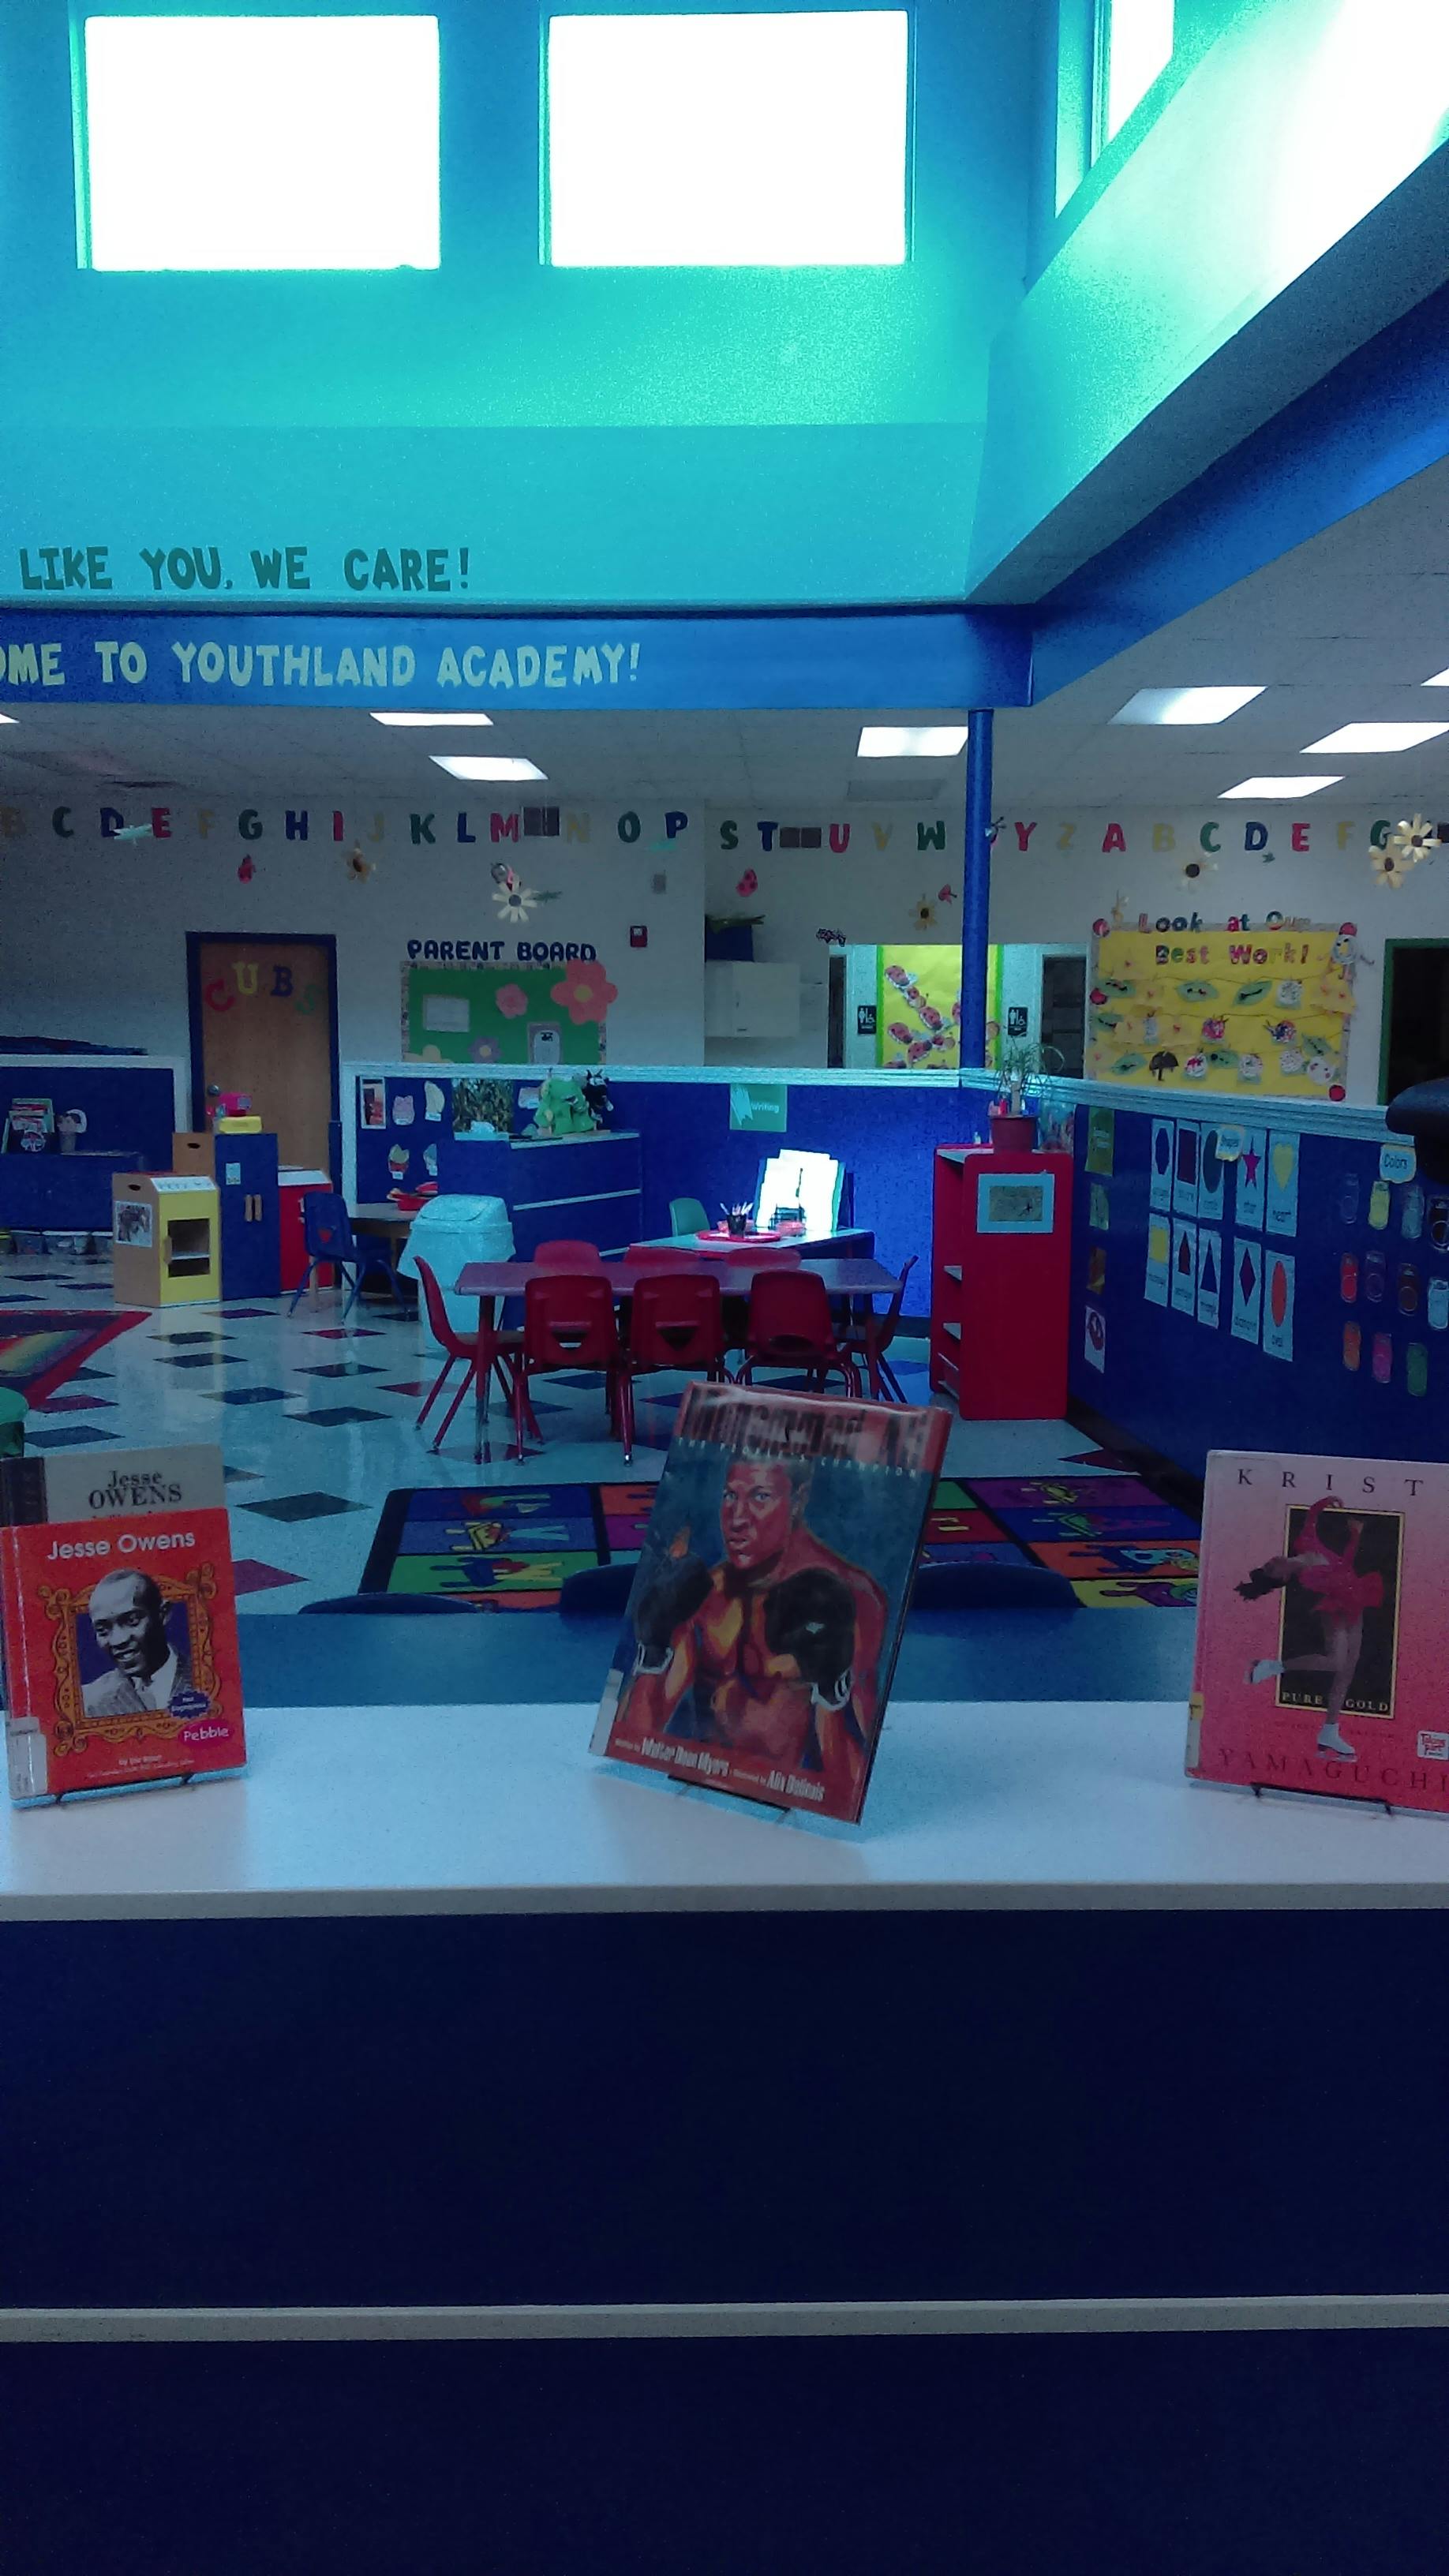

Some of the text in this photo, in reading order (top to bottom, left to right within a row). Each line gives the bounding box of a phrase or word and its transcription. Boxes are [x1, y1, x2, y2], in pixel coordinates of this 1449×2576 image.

[20, 546, 470, 591] LIKE YOU, WE CARE!
[0, 642, 640, 688] ME TO YOUTHLAND ACADEMY!
[52, 805, 74, 838] C
[100, 807, 124, 838] D
[151, 807, 172, 838] E
[197, 809, 215, 839] F
[238, 809, 264, 841] G
[285, 811, 309, 841] H
[332, 811, 343, 841] I
[410, 814, 436, 844] K
[457, 812, 476, 843] L
[489, 812, 520, 844] M
[566, 813, 590, 844] N
[617, 811, 642, 844] O
[665, 811, 688, 839] P
[720, 820, 739, 850] S
[758, 821, 778, 852] T
[829, 823, 850, 853] U
[916, 820, 945, 852] W
[1014, 822, 1038, 852] Y
[1102, 822, 1127, 852] A
[1151, 823, 1176, 852] B
[1200, 822, 1222, 853] C
[1245, 822, 1269, 852] D
[1291, 822, 1310, 852] E
[1336, 822, 1354, 849] F
[1369, 820, 1391, 850] G
[1138, 912, 1203, 933] Look
[1226, 913, 1251, 932] at
[406, 940, 597, 962] PARENT BOARD
[1155, 943, 1309, 965] Best Work!
[751, 1102, 780, 1114] Writing
[1384, 1151, 1408, 1170] Colors
[107, 1470, 163, 1488] Jesse
[88, 1483, 182, 1510] OWENS
[47, 1530, 196, 1560] Jesse Owens
[1282, 1691, 1389, 1713] PURE GOLD
[183, 1726, 230, 1742] Pebble
